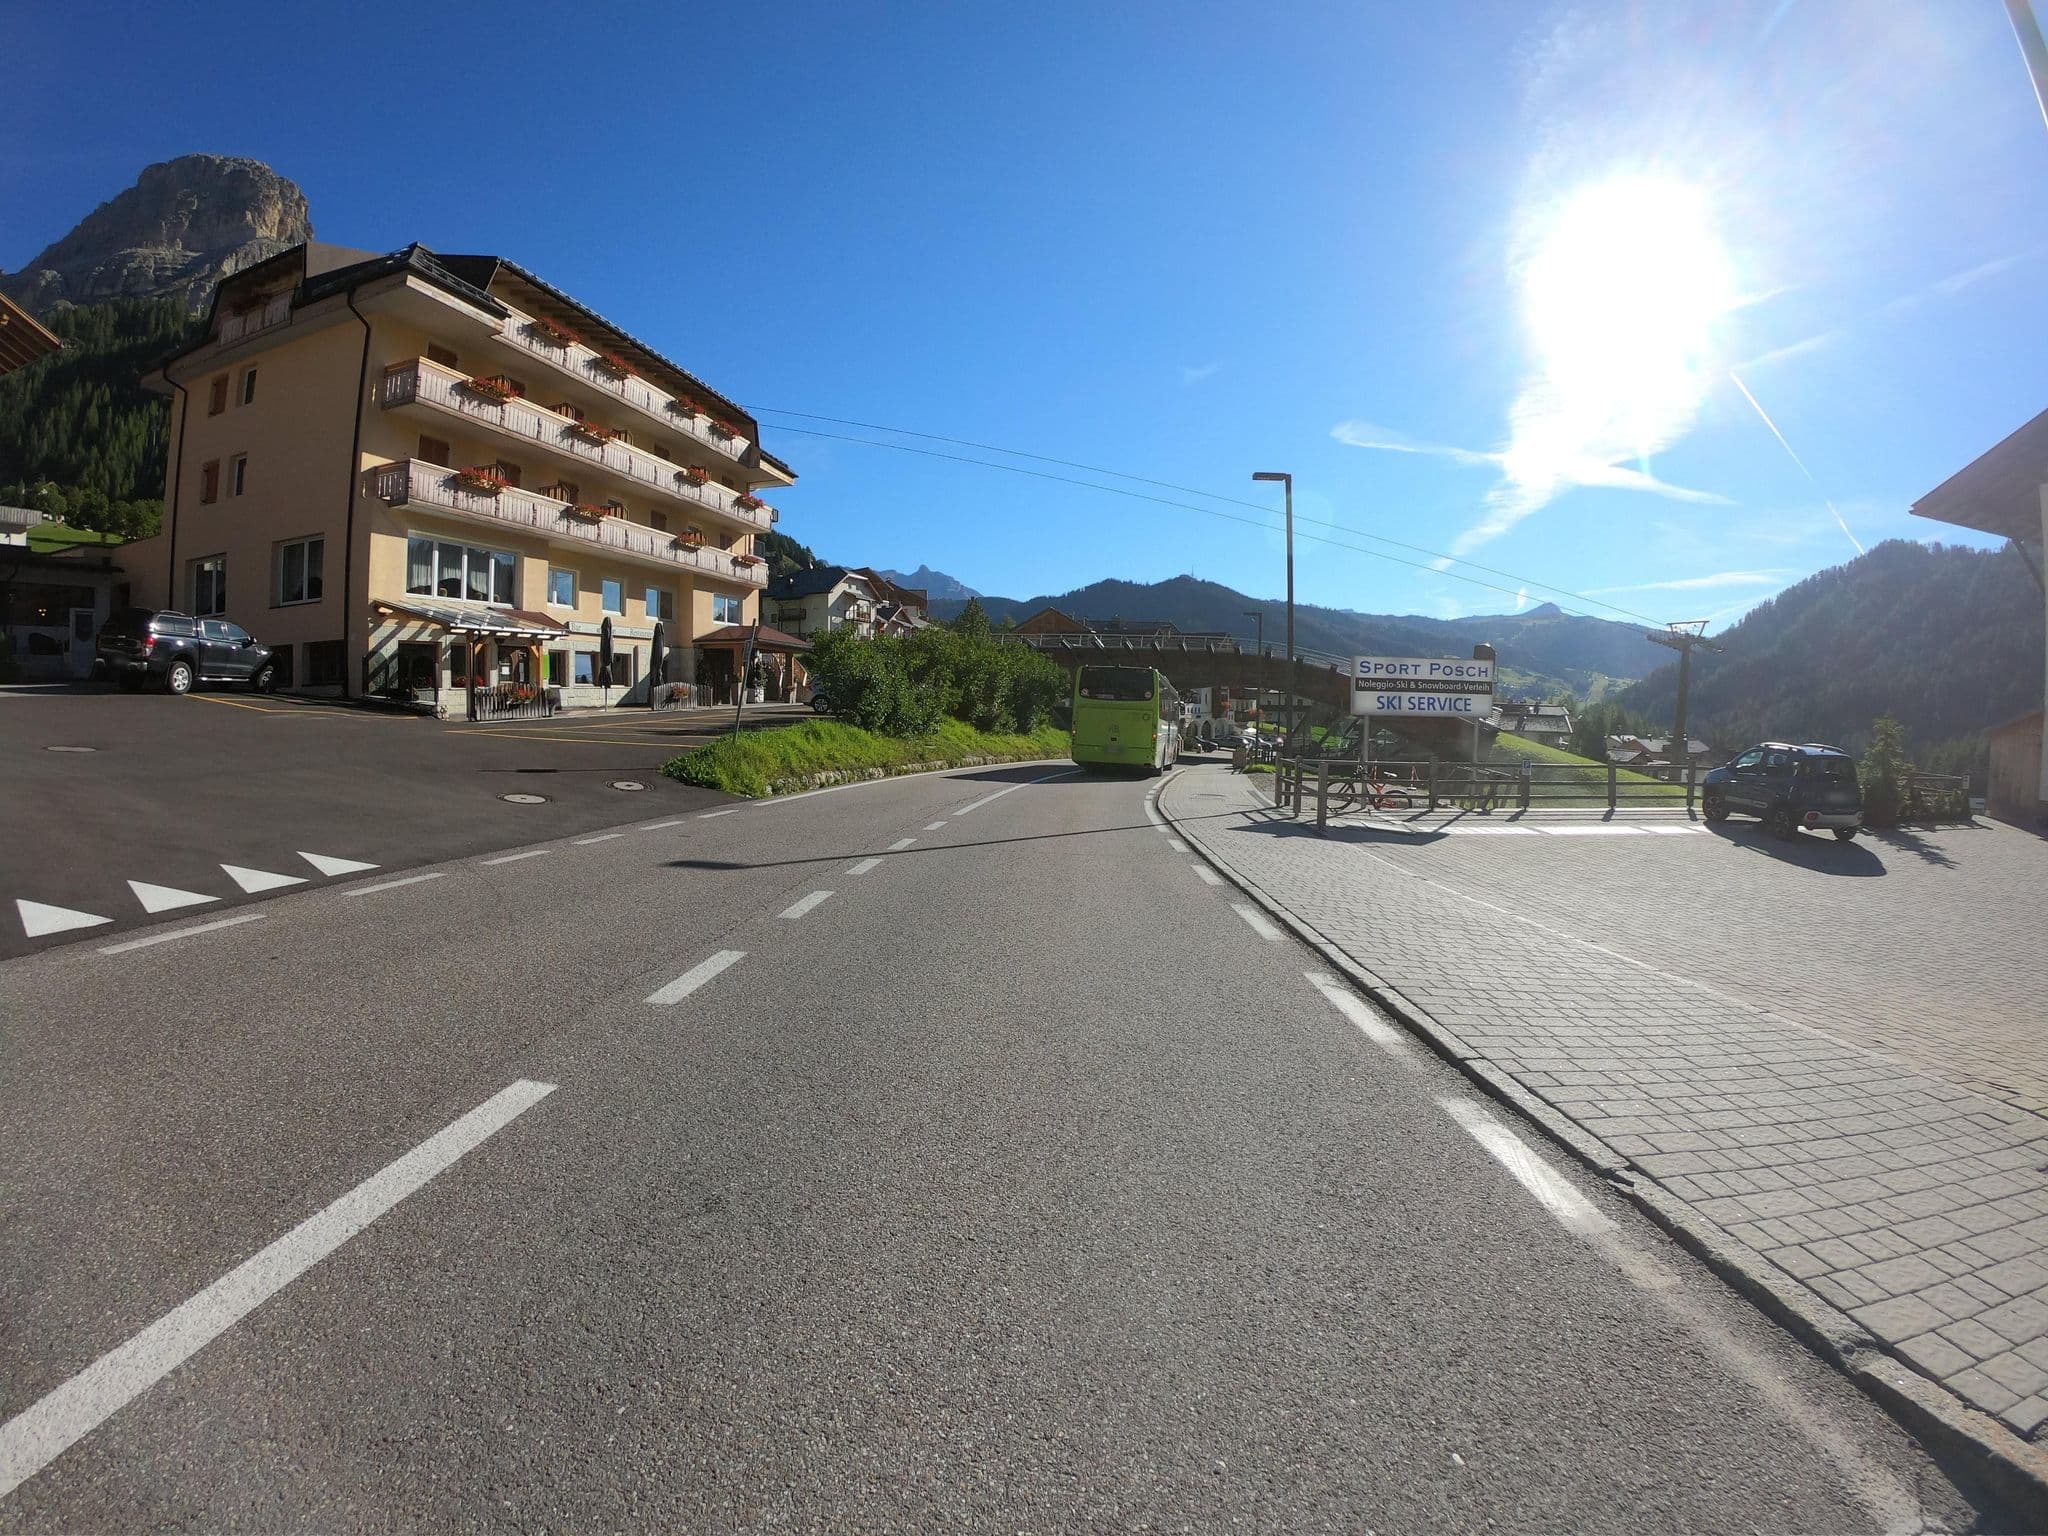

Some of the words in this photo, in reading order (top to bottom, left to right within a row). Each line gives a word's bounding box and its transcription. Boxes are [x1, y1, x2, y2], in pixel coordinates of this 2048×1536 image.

[1360, 661, 1421, 675] SPORT
[1429, 662, 1489, 678] POSCH
[1409, 681, 1416, 689] &
[1417, 681, 1490, 692] Snowboard-Verleih
[1376, 695, 1402, 710] SKI
[1407, 696, 1472, 712] SERVICE
